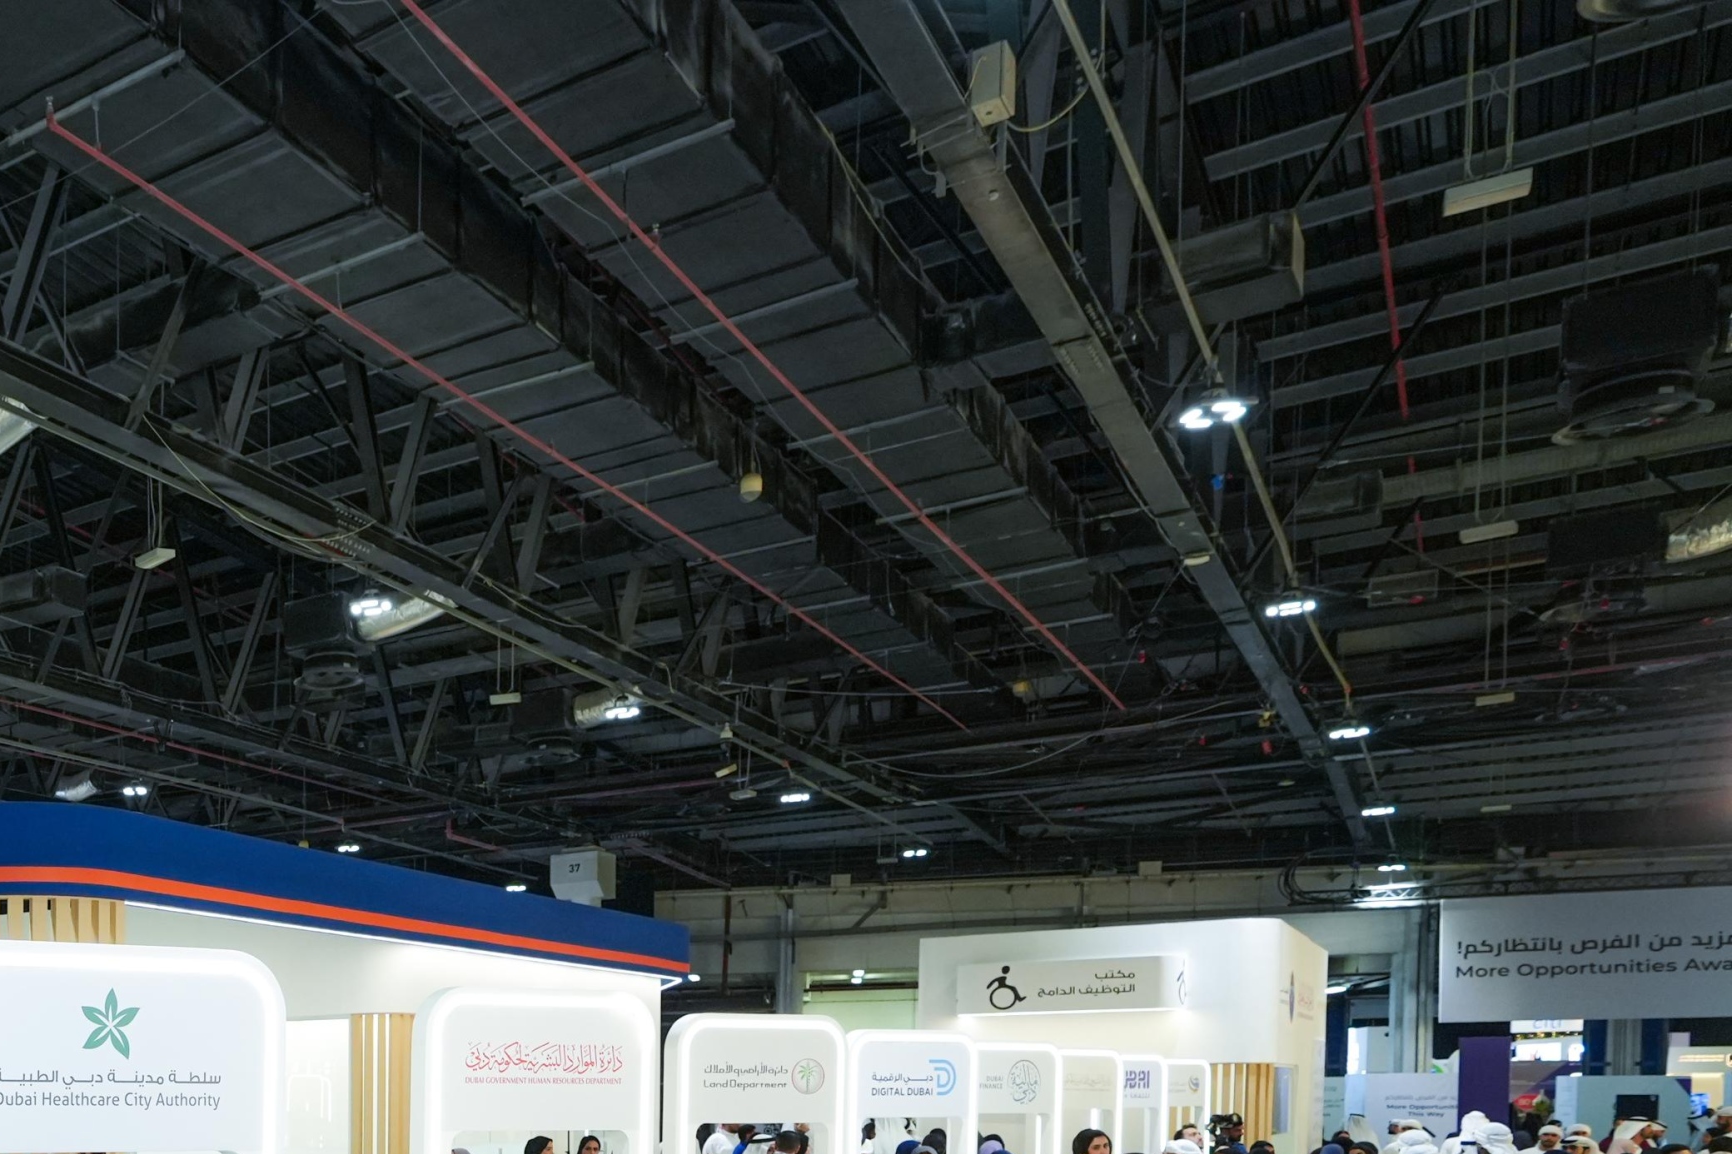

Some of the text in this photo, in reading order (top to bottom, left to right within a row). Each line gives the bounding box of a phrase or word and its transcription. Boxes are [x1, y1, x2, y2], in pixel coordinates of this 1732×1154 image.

[1570, 934, 1640, 955] الفرص
[1649, 934, 1682, 952] من
[1095, 969, 1135, 980] مكتب
[1456, 965, 1510, 979] More
[1517, 959, 1678, 979] Opportunities
[1037, 983, 1135, 998] التوظيف الدامج
[62, 1073, 103, 1089] دبي
[107, 1069, 164, 1087] مدينة
[168, 1069, 221, 1084] سلطة
[486, 1077, 527, 1085] GOVERNMENT
[528, 1077, 551, 1085] HUMAN
[552, 1077, 584, 1085] RESOURCES
[872, 1072, 903, 1084] الرقمية
[1124, 1070, 1150, 1089] BAI
[703, 1079, 787, 1091] Land Department
[871, 1087, 933, 1096] DIGITAL DUBAI
[42, 1091, 120, 1107] Healthcare
[124, 1092, 152, 1110] City
[156, 1092, 220, 1110] Authority
